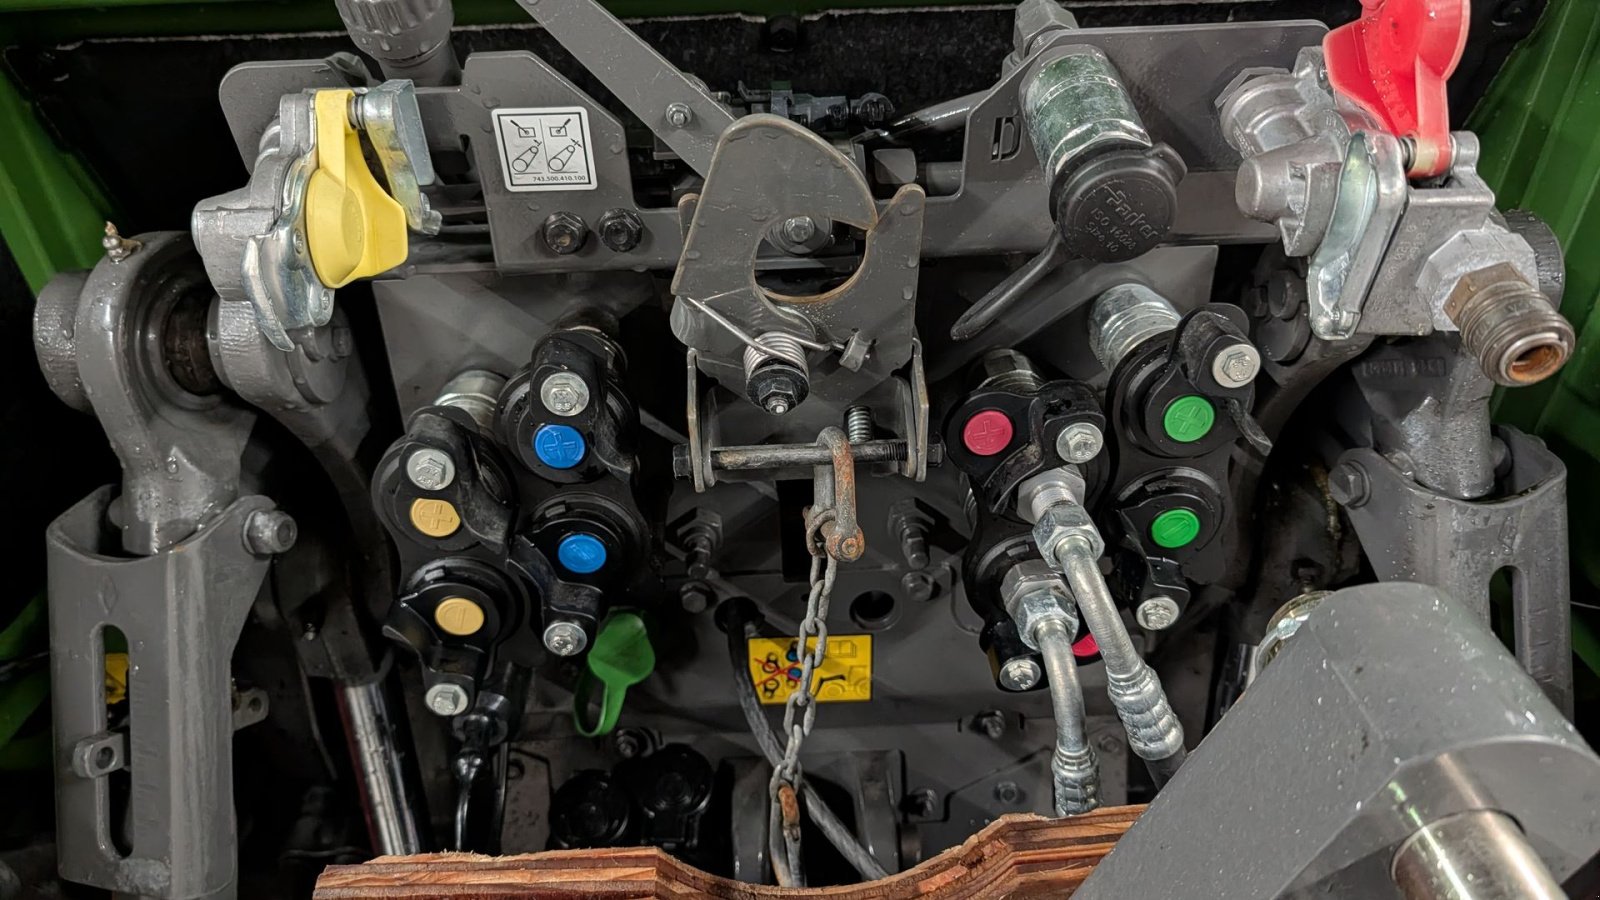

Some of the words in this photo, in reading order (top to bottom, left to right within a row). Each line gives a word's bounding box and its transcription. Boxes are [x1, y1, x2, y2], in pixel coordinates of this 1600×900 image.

[533, 175, 586, 183] 743.500.410.100
[1090, 207, 1110, 226] ISO
[1104, 185, 1159, 239] Parker
[1106, 241, 1119, 253] 10
